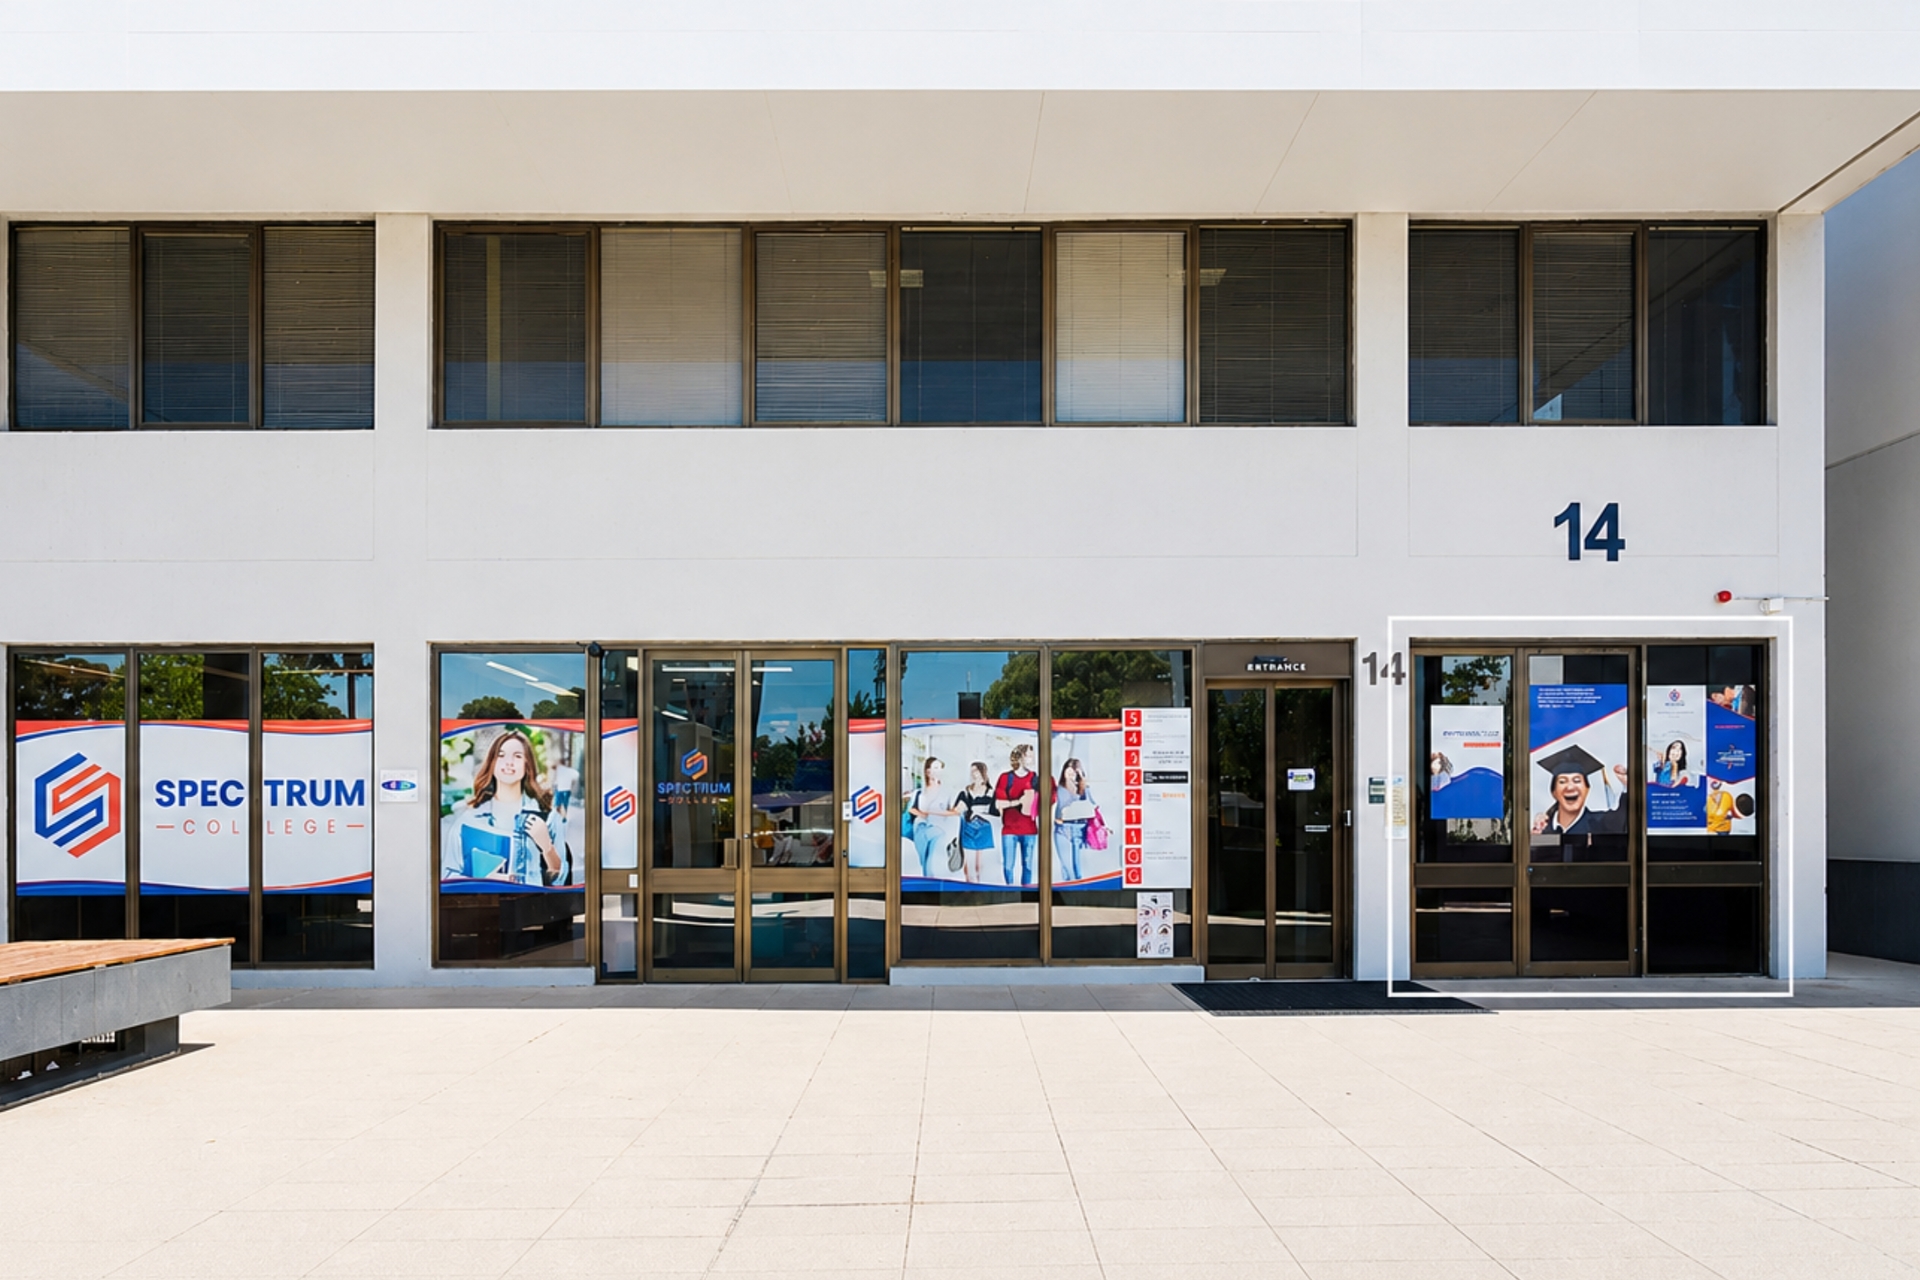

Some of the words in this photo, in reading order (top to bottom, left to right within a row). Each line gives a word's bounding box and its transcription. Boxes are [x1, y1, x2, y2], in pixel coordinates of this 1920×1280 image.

[1554, 502, 1626, 562] 14
[1362, 651, 1406, 686] 14
[1129, 711, 1138, 725] 5
[1129, 770, 1139, 785] 2
[155, 779, 365, 808] SPECTRUM
[1129, 790, 1137, 804] 2
